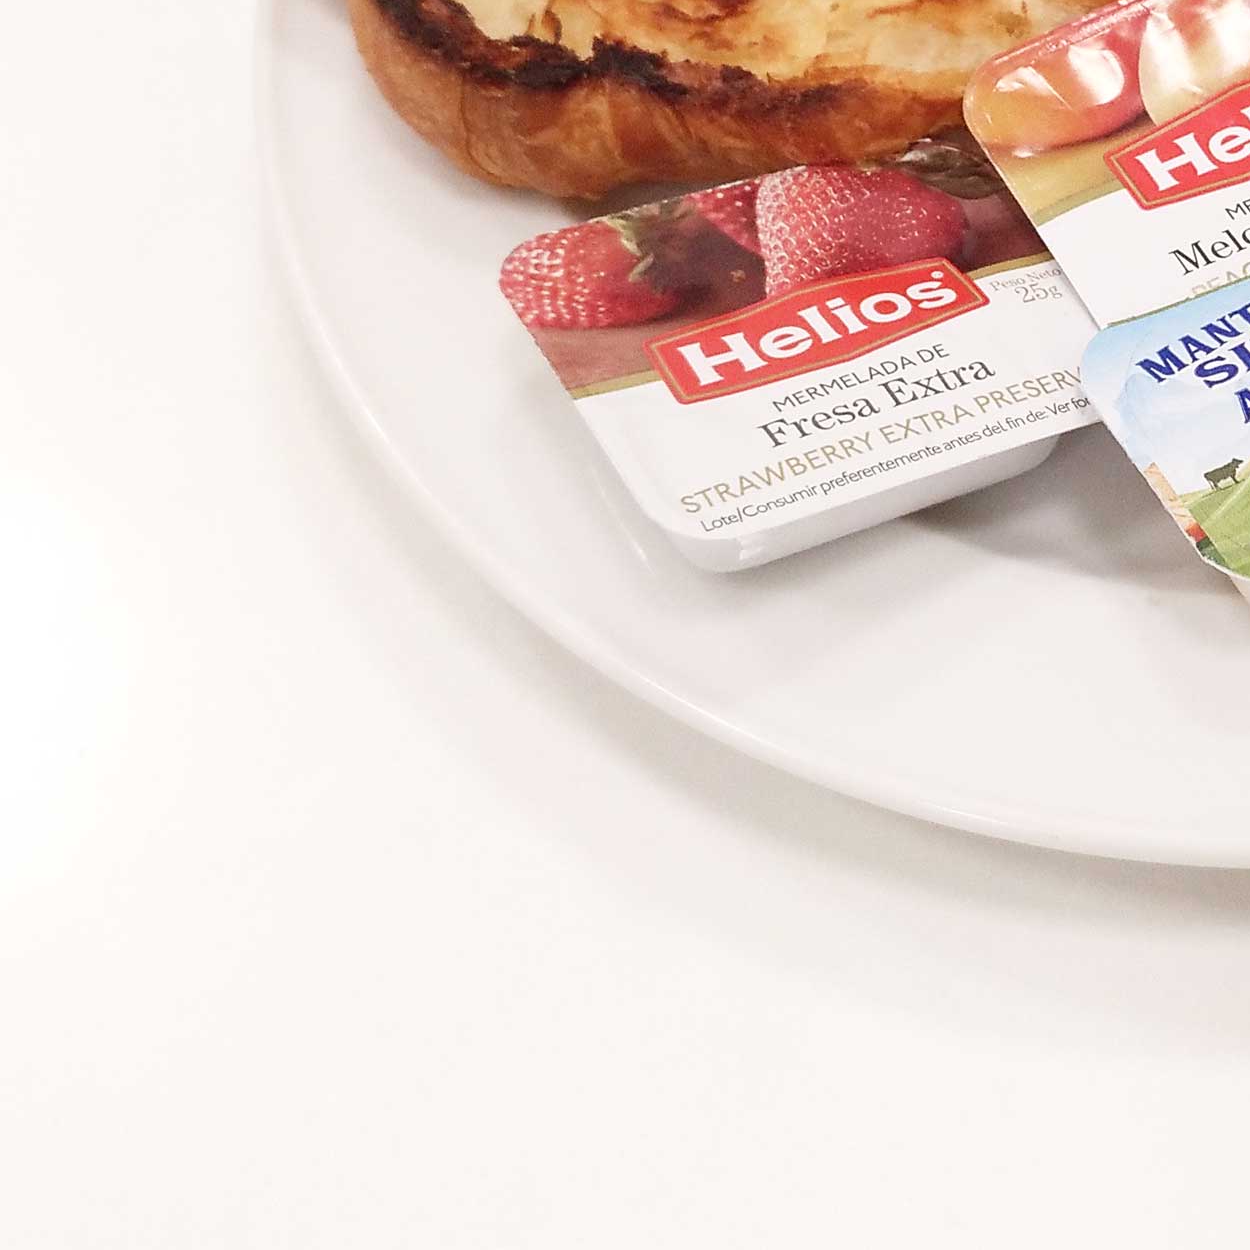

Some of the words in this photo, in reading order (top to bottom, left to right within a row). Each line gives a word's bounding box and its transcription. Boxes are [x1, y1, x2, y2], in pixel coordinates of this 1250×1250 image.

[989, 277, 1026, 292] Peso
[1025, 268, 1062, 283] Neto
[1014, 282, 1063, 303] 25g
[677, 280, 957, 386] Helios
[772, 356, 917, 412] MERMELADA
[916, 343, 950, 363] DE
[680, 431, 874, 513] STRAWBERRY
[879, 403, 976, 445] EXTRA
[972, 366, 1082, 414] PRESERV
[757, 396, 881, 448] Fresa
[877, 359, 997, 408] Extra
[700, 485, 823, 532] Lote/Consumir
[819, 444, 943, 496] preferentemente
[943, 431, 983, 451] antes
[982, 420, 1007, 437] del
[1005, 415, 1026, 430] fin
[1045, 400, 1071, 416] Ver
